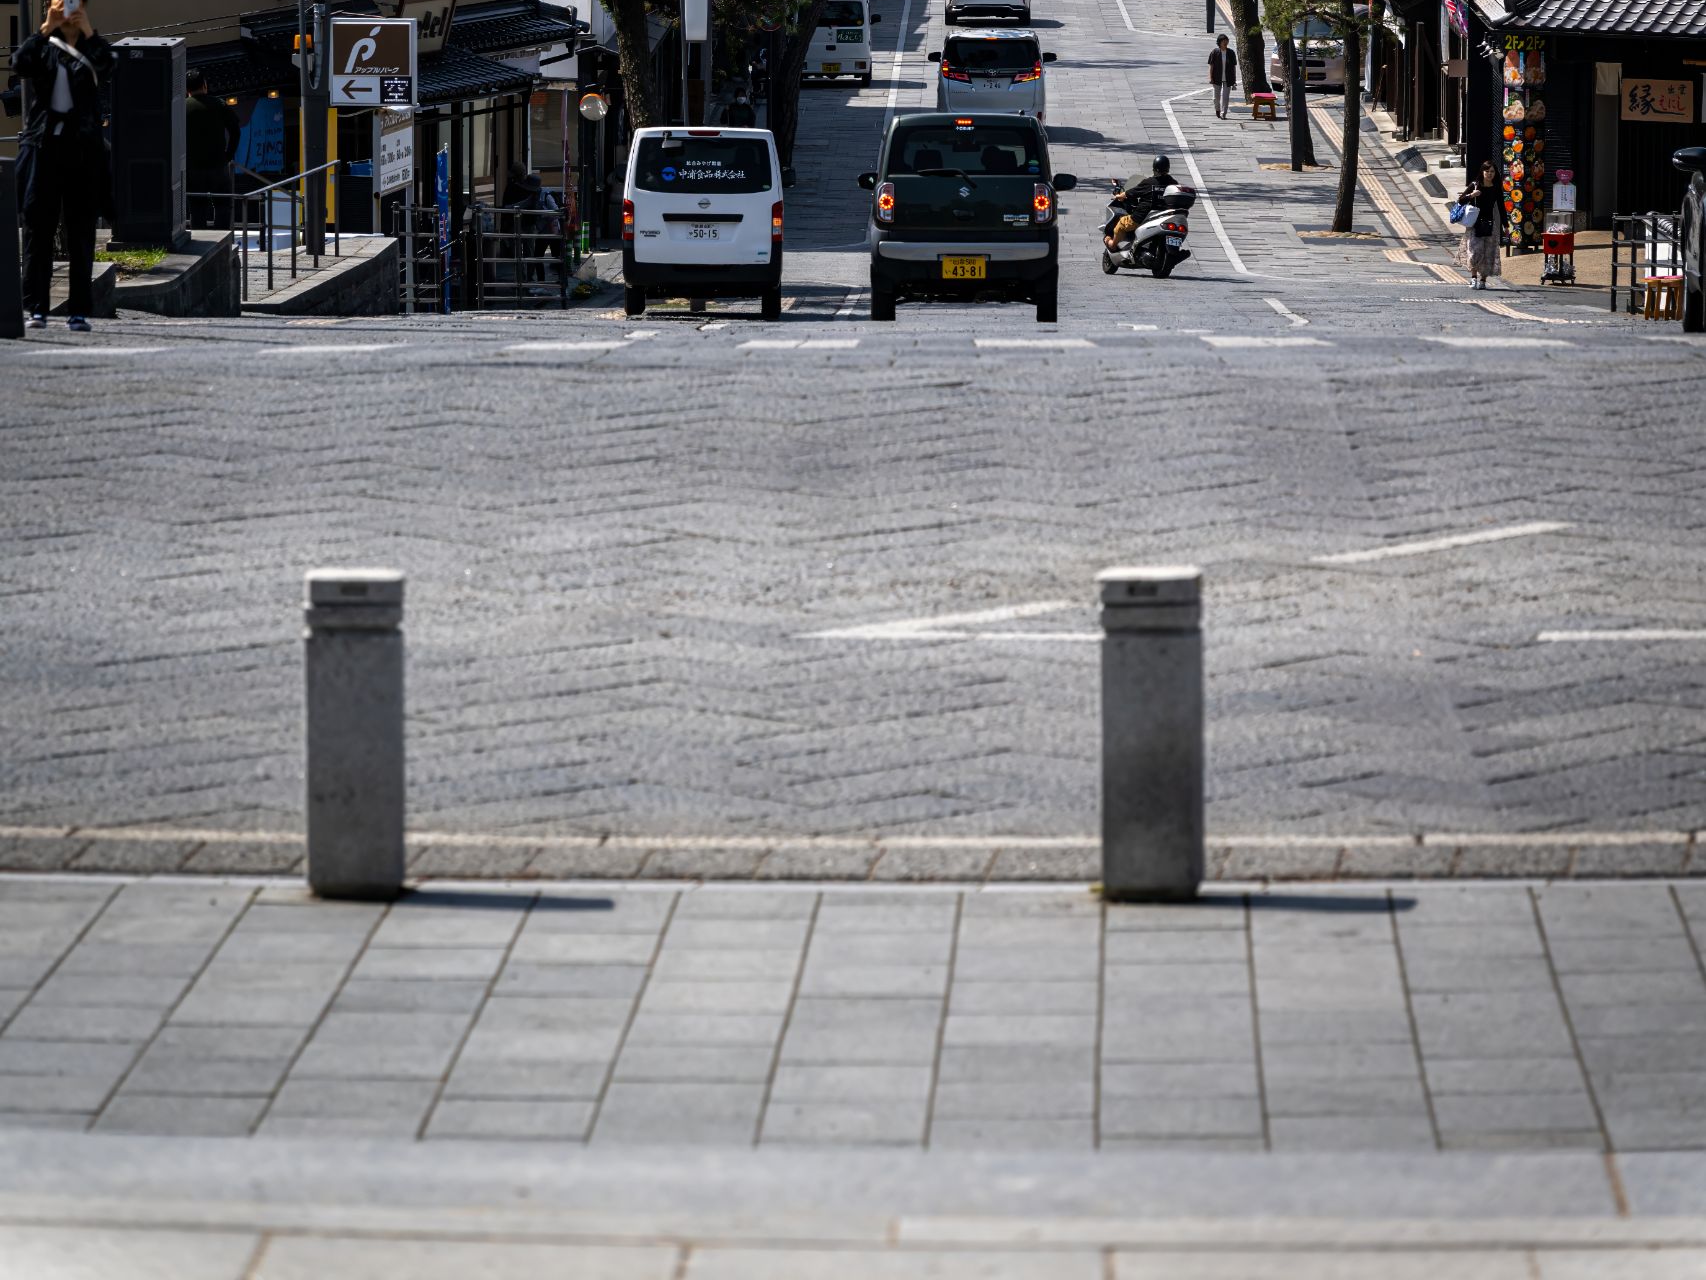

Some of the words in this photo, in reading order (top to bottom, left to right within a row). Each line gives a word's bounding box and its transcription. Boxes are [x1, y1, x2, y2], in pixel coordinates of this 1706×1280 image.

[1504, 34, 1519, 50] 2F
[1526, 36, 1540, 50] 2F
[353, 66, 400, 74] アップルパーク
[678, 169, 746, 180] 中浦食品株式会社
[693, 229, 718, 238] 50-15
[952, 265, 982, 277] 43-81
